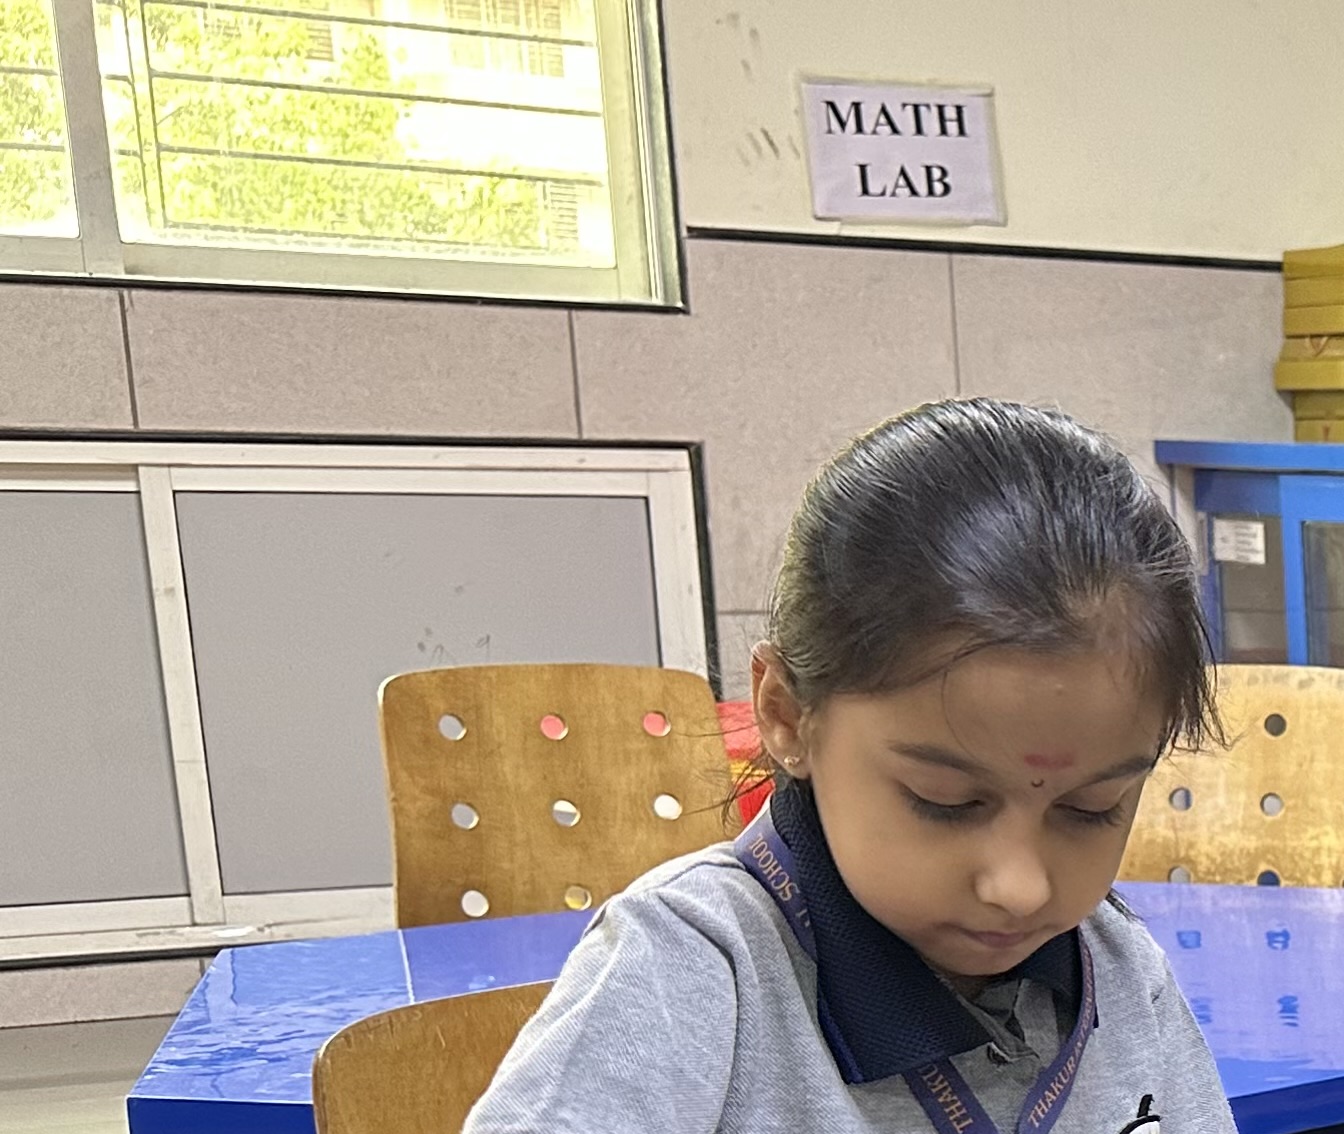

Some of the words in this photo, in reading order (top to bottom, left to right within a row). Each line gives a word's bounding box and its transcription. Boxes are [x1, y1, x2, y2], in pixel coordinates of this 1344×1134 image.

[822, 100, 970, 138] MATH
[855, 163, 953, 198] LAB
[748, 834, 798, 902] SCHOOL
[1028, 1057, 1079, 1129] THAKUR
